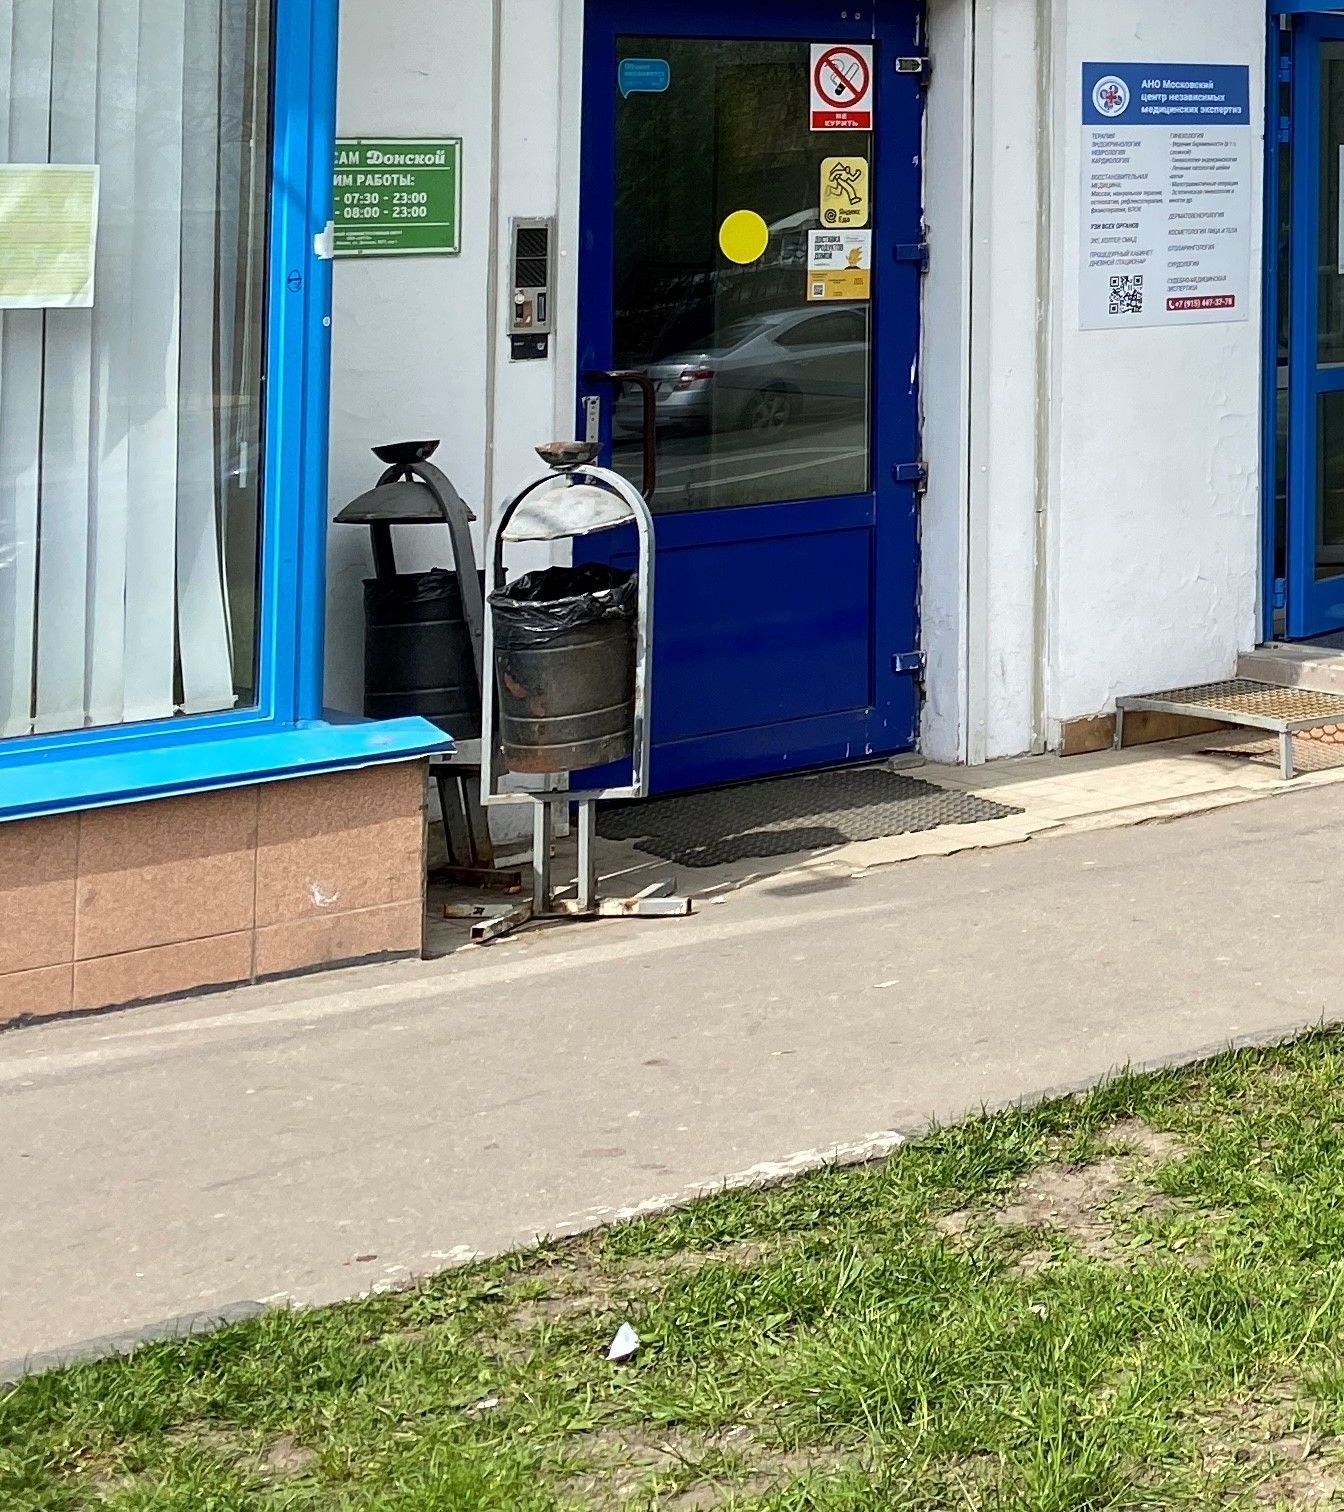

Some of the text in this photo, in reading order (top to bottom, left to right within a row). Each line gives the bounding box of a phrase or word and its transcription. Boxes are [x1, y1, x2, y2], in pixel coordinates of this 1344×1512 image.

[1140, 80, 1214, 89] АНО Московский
[1140, 93, 1226, 103] центр независимых
[1140, 105, 1242, 115] медицинских экспертиз
[366, 150, 446, 165] Донской
[356, 174, 415, 186] РАБОТЫ:
[343, 193, 379, 204] 07:30
[393, 192, 427, 204] 23:00
[343, 207, 380, 218] 08:00
[392, 206, 427, 218] 23:00
